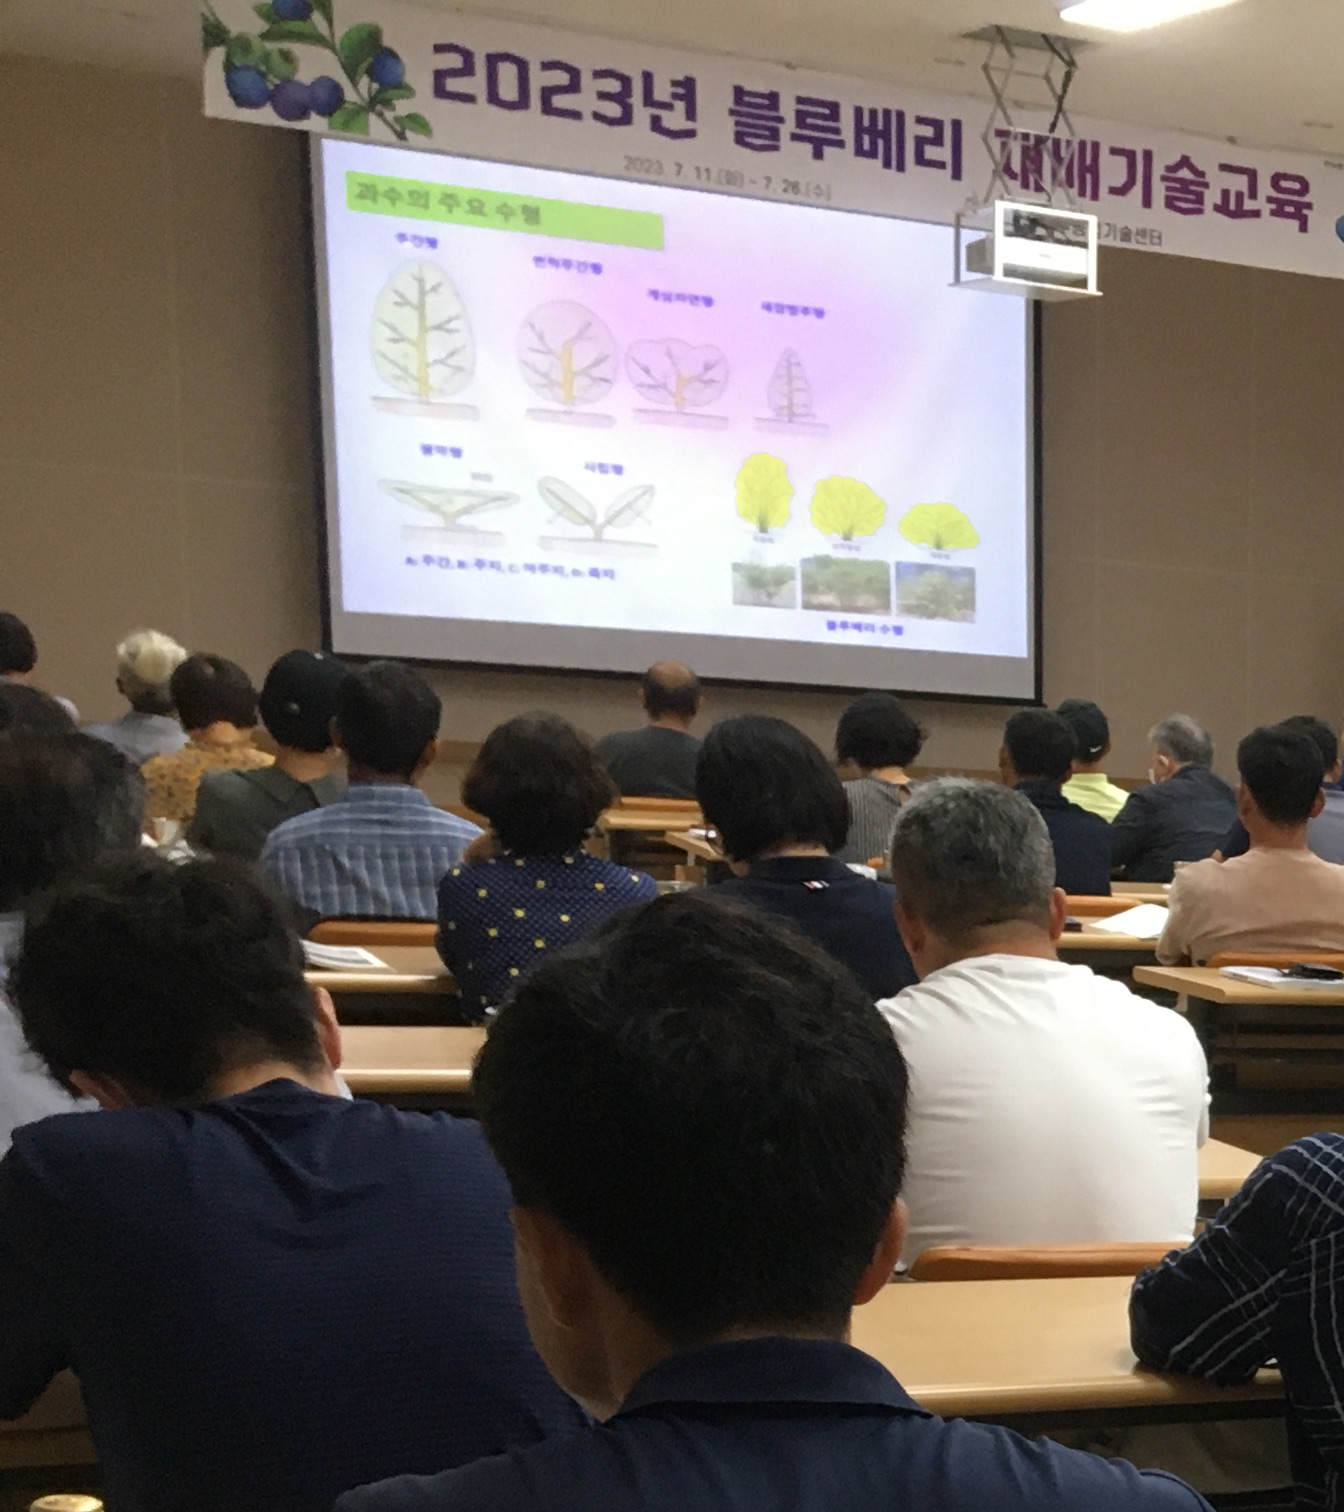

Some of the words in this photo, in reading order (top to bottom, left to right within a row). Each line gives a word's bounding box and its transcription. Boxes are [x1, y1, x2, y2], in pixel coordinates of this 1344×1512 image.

[432, 42, 698, 140] 2023년
[729, 85, 963, 182] 블루베리
[437, 191, 489, 217] 주요
